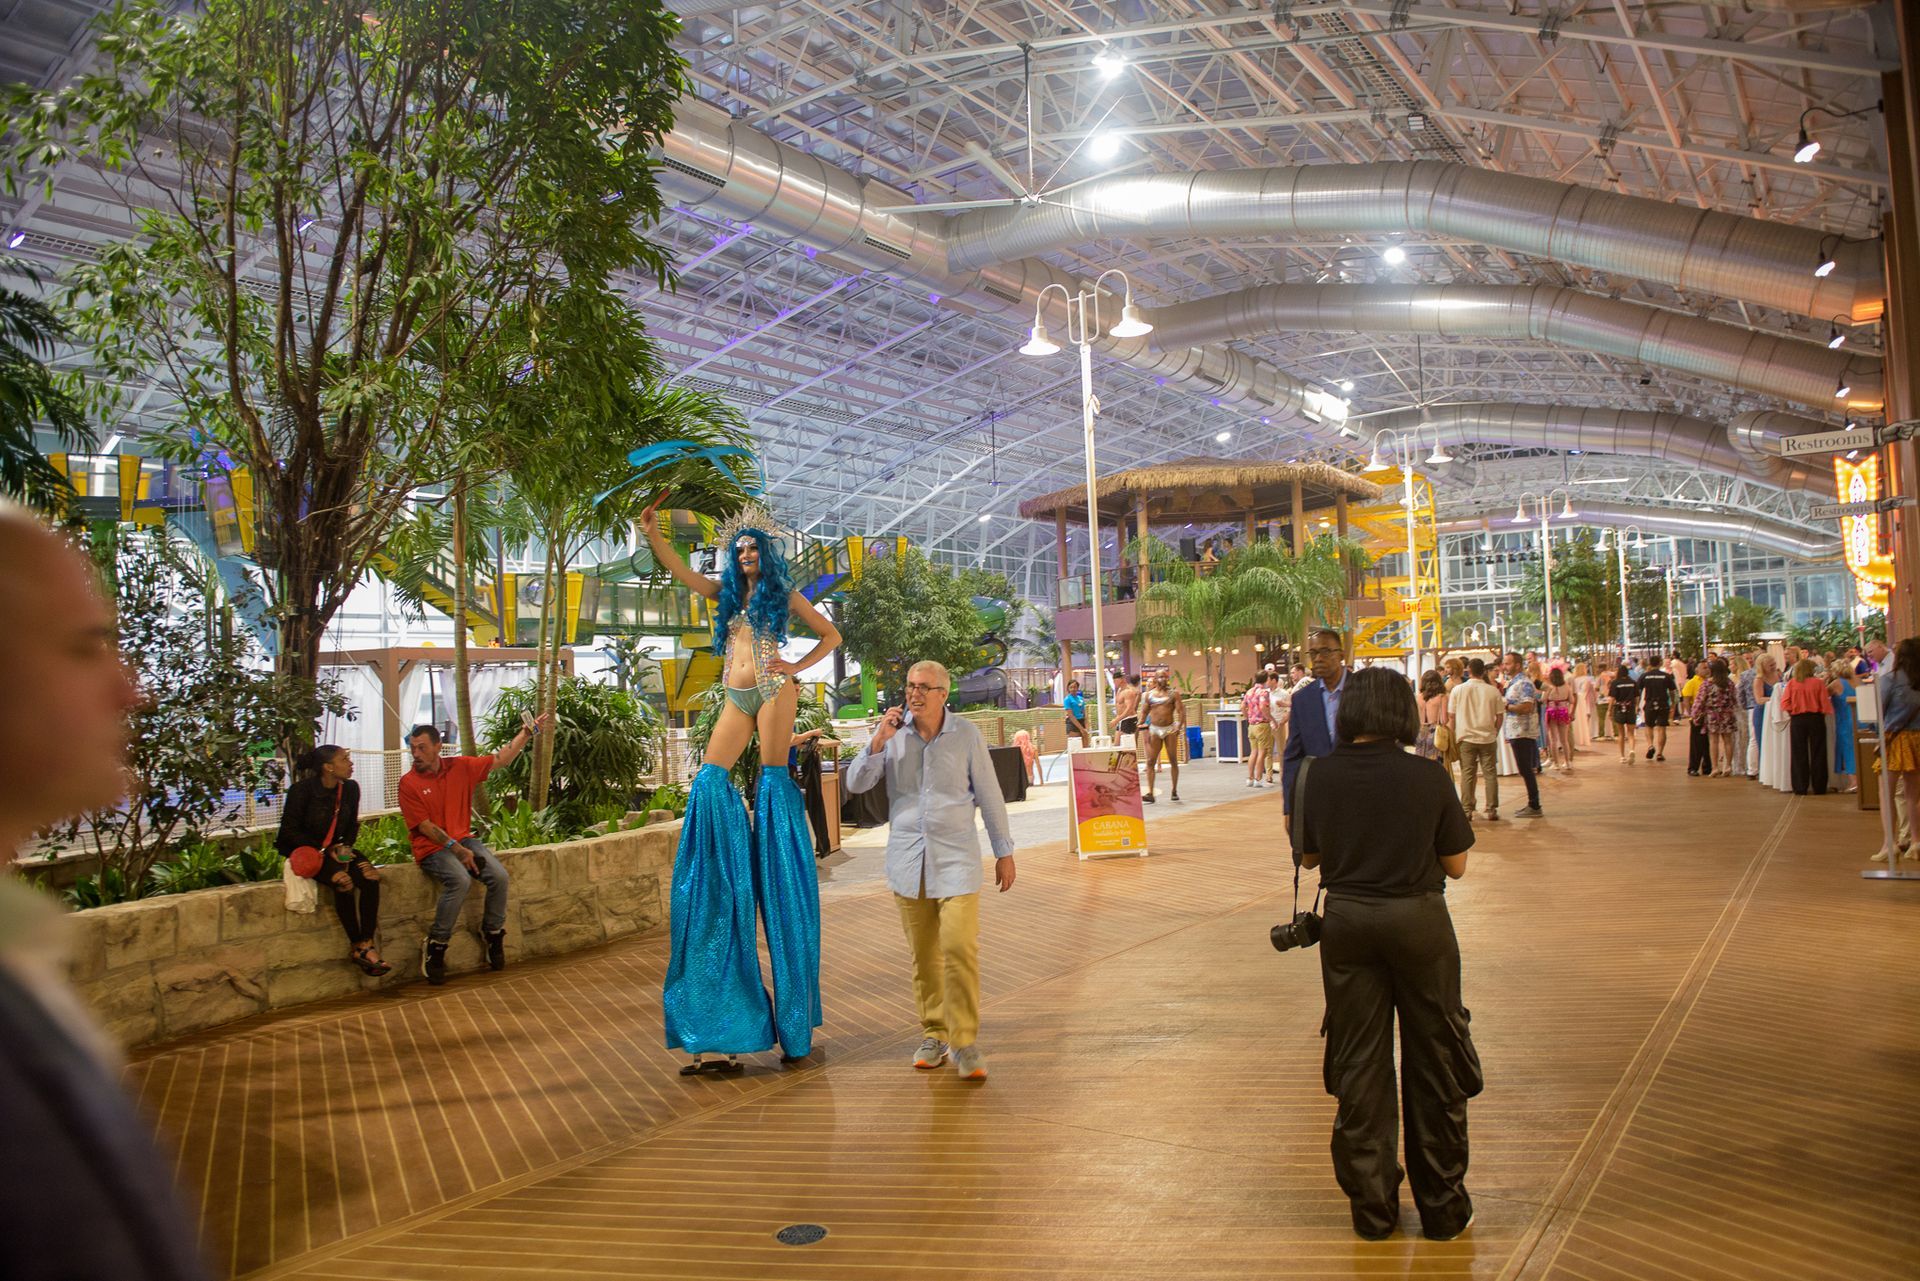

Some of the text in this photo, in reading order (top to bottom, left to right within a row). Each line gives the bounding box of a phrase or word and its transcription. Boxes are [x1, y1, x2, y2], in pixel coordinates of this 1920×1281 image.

[1786, 434, 1870, 452] Restrooms
[1814, 505, 1873, 518] Restrooms
[1093, 820, 1130, 830] CABANA
